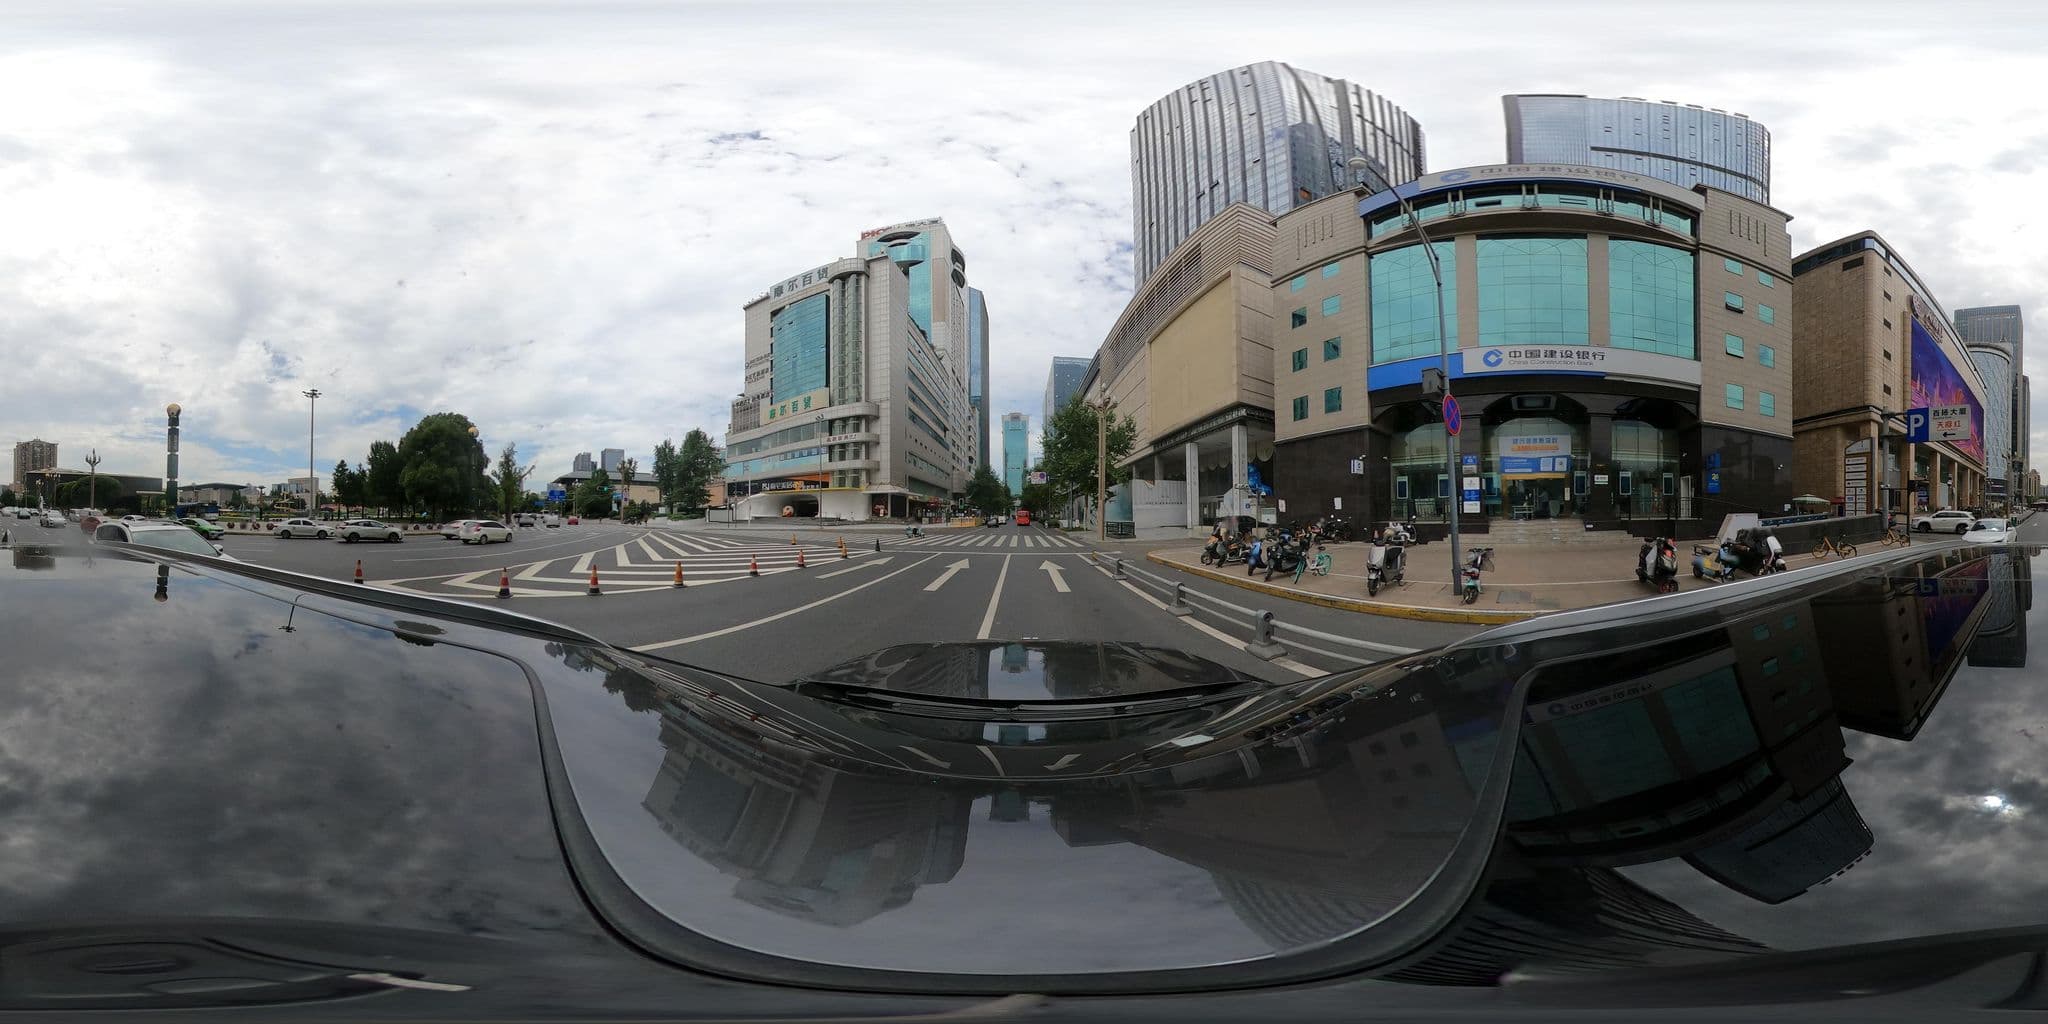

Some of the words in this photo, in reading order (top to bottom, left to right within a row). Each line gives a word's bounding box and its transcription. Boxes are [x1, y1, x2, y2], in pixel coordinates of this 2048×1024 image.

[773, 266, 828, 299] 摩尔百货
[1508, 349, 1606, 361] 中国建设银行
[1909, 414, 1925, 437] P
